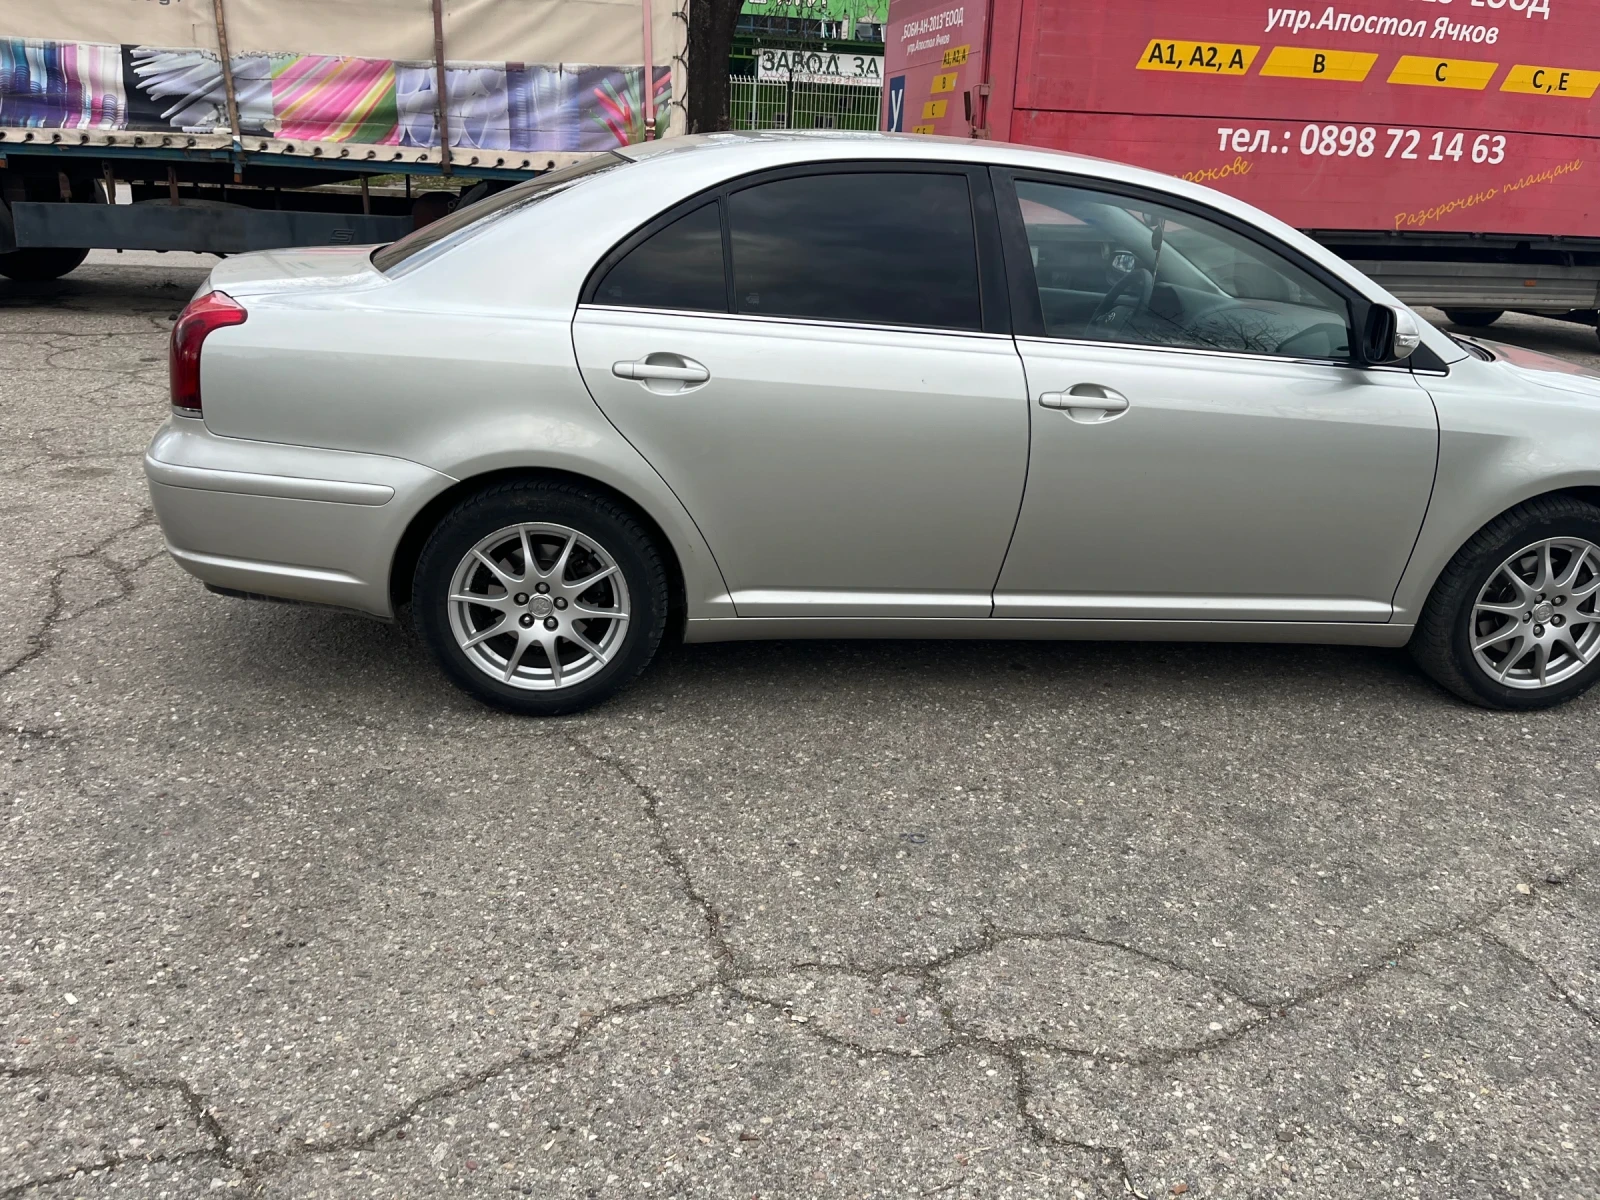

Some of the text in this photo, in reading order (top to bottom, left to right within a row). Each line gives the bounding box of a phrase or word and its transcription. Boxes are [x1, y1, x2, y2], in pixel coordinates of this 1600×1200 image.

[1264, 7, 1499, 44] упр.Апостол Ячков
[853, 56, 880, 78] ЗА
[1148, 43, 1244, 72] A1, A2, A
[1312, 53, 1326, 73] B
[942, 77, 947, 89] B
[1435, 62, 1448, 82] C
[931, 103, 936, 116] C
[1217, 124, 1506, 165] тел.: 0898 72 14 63
[1173, 156, 1253, 183] рокове
[1395, 158, 1584, 230] Разсрочено плащане
